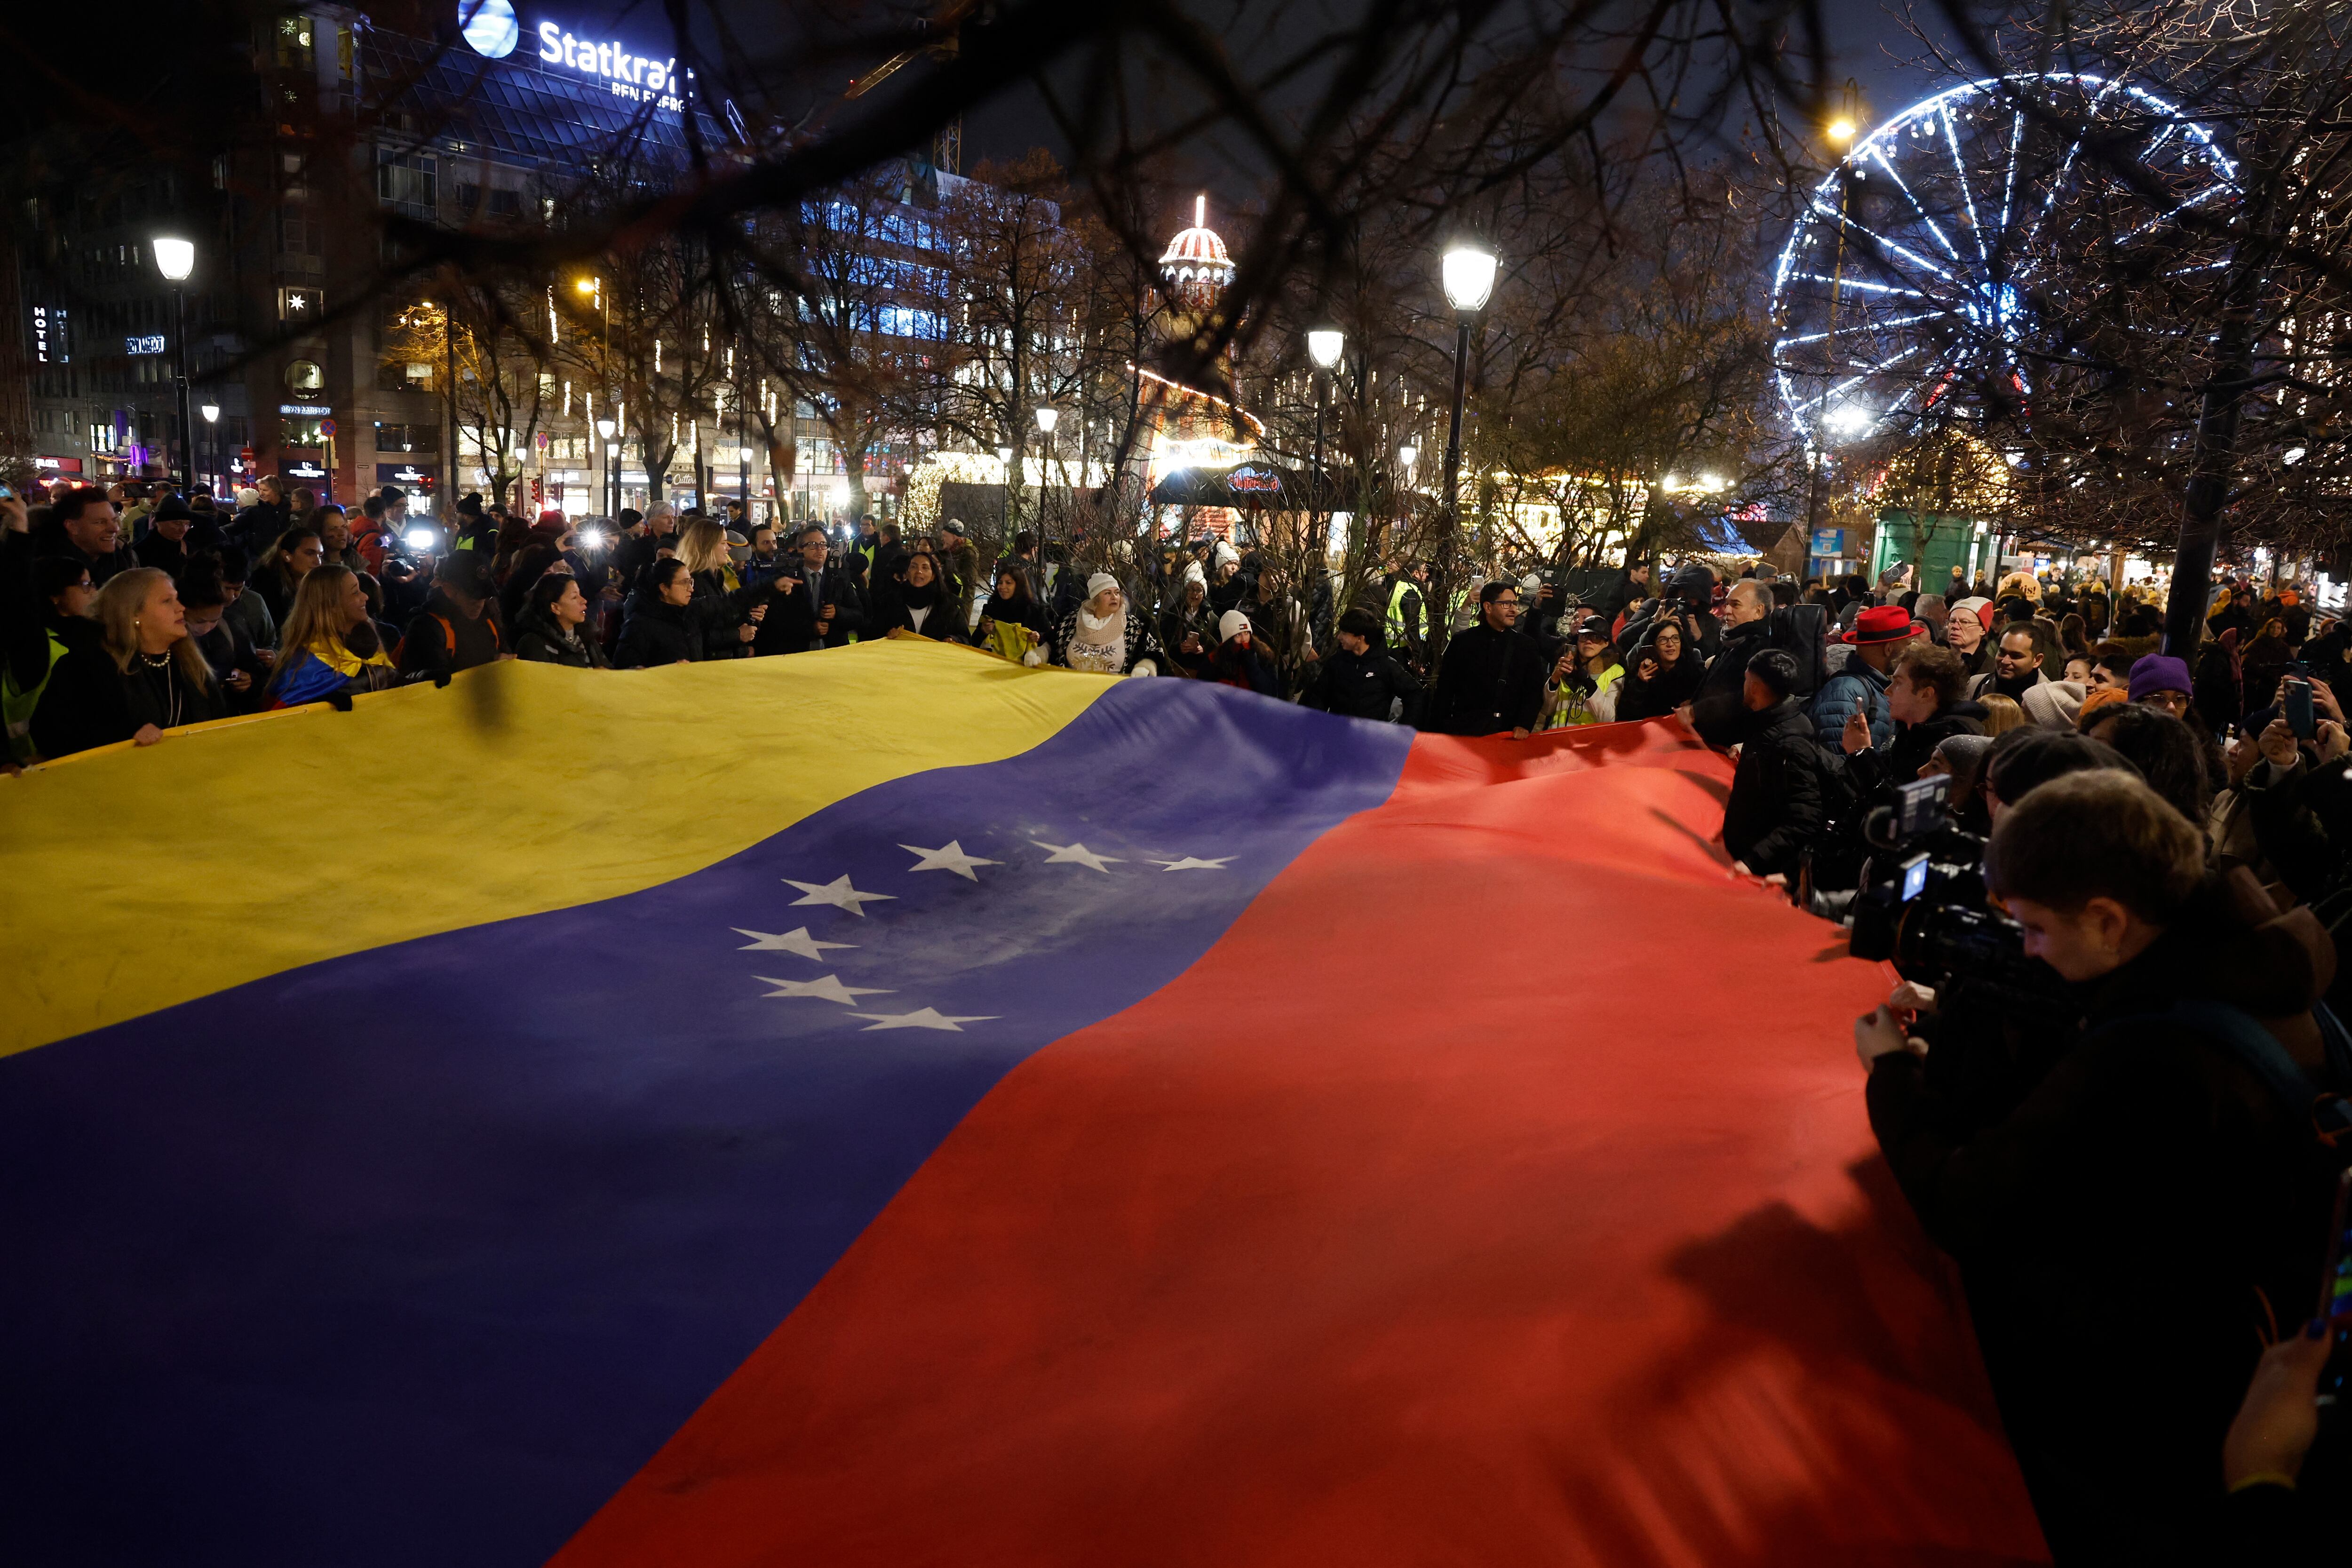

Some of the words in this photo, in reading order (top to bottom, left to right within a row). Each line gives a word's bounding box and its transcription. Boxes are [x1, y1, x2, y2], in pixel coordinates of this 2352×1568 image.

[540, 22, 694, 98] Statkra
[644, 90, 692, 113] EERG
[34, 307, 48, 362] HOTEL
[673, 473, 696, 485] Cutters
